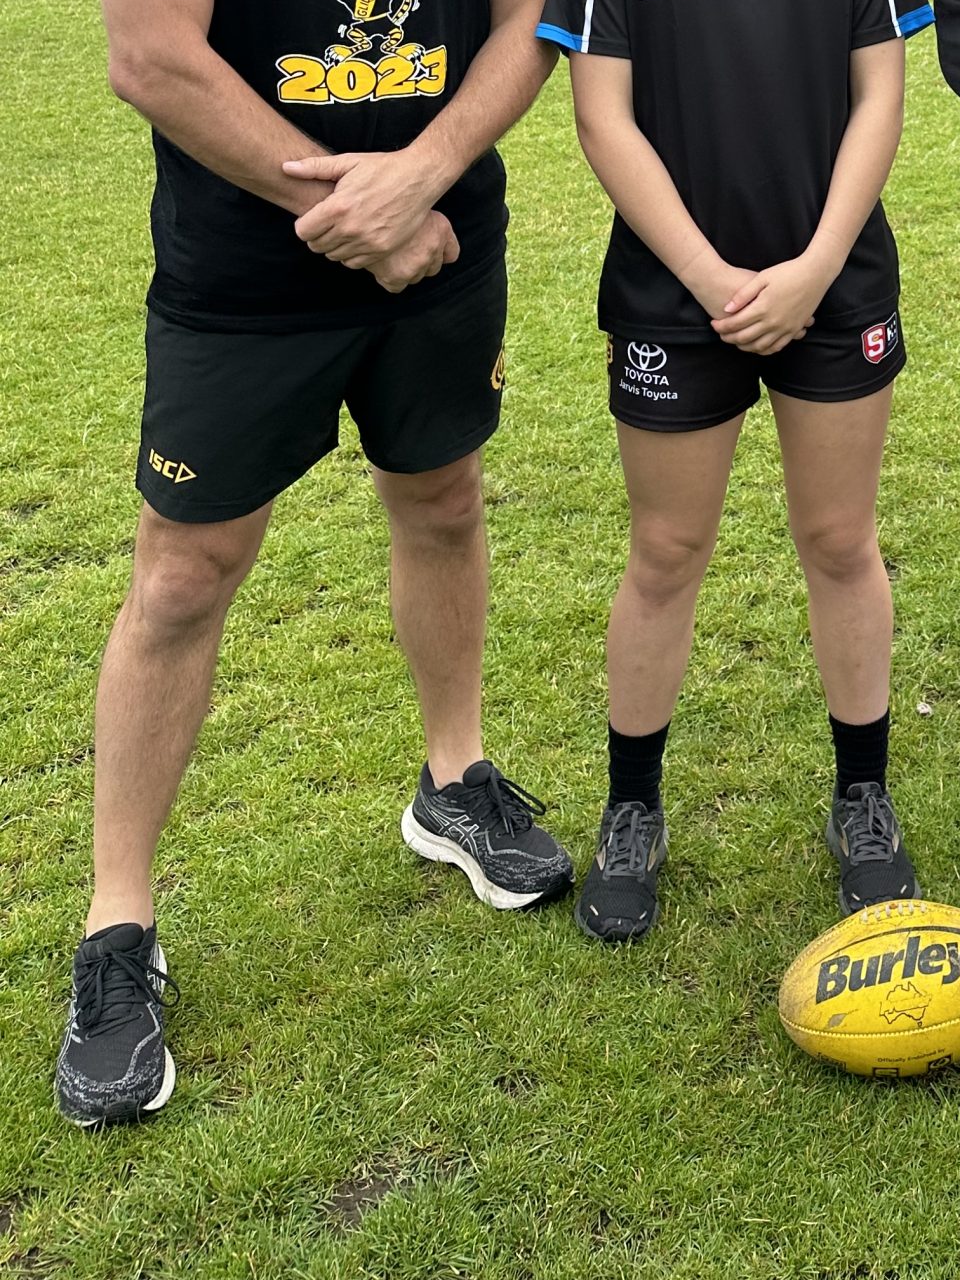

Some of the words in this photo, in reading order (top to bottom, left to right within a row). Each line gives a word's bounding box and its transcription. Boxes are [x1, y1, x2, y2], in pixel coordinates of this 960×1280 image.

[275, 45, 447, 105] 2023
[619, 378, 640, 395] Jarvis
[641, 387, 678, 401] Toyota
[624, 365, 670, 386] TOYOTA
[148, 447, 178, 480] ISC
